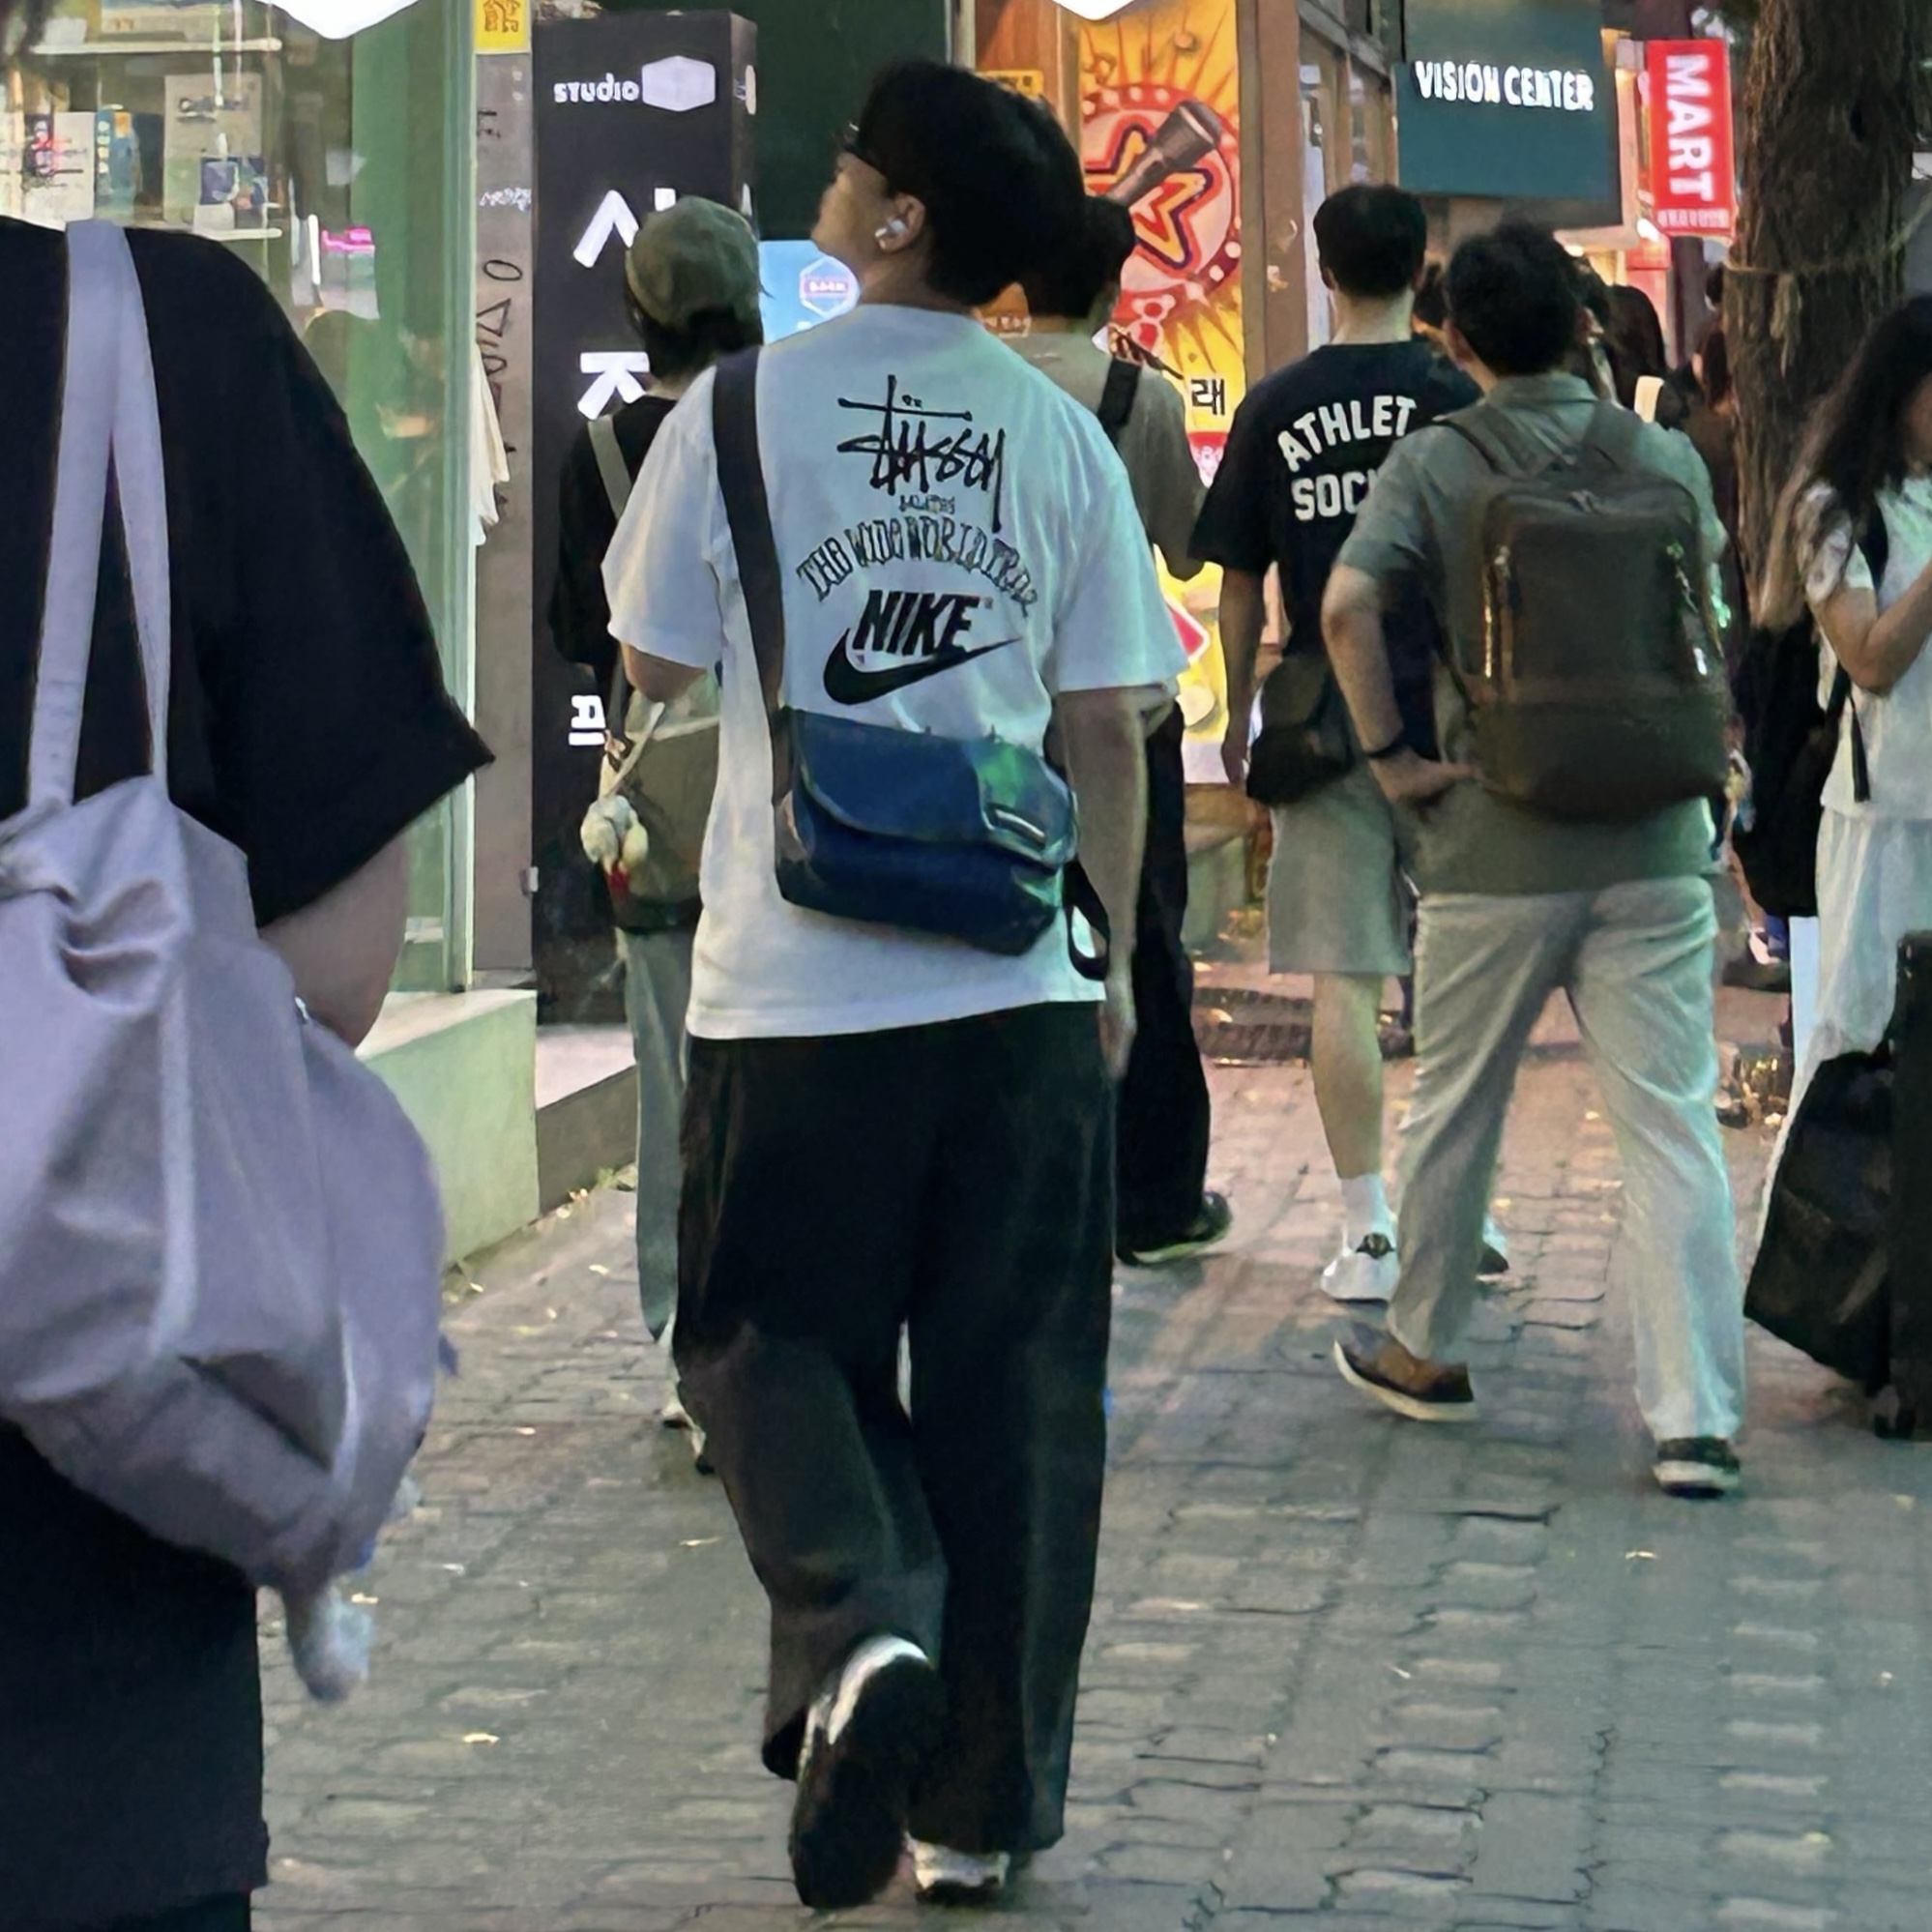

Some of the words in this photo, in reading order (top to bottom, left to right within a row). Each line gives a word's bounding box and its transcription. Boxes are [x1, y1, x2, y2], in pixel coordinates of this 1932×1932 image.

[1415, 60, 1500, 103] VISION
[1504, 67, 1594, 111] CENTER
[1666, 54, 1713, 201] MART
[1277, 395, 1418, 472] ATHLET
[852, 589, 980, 659] NIKE
